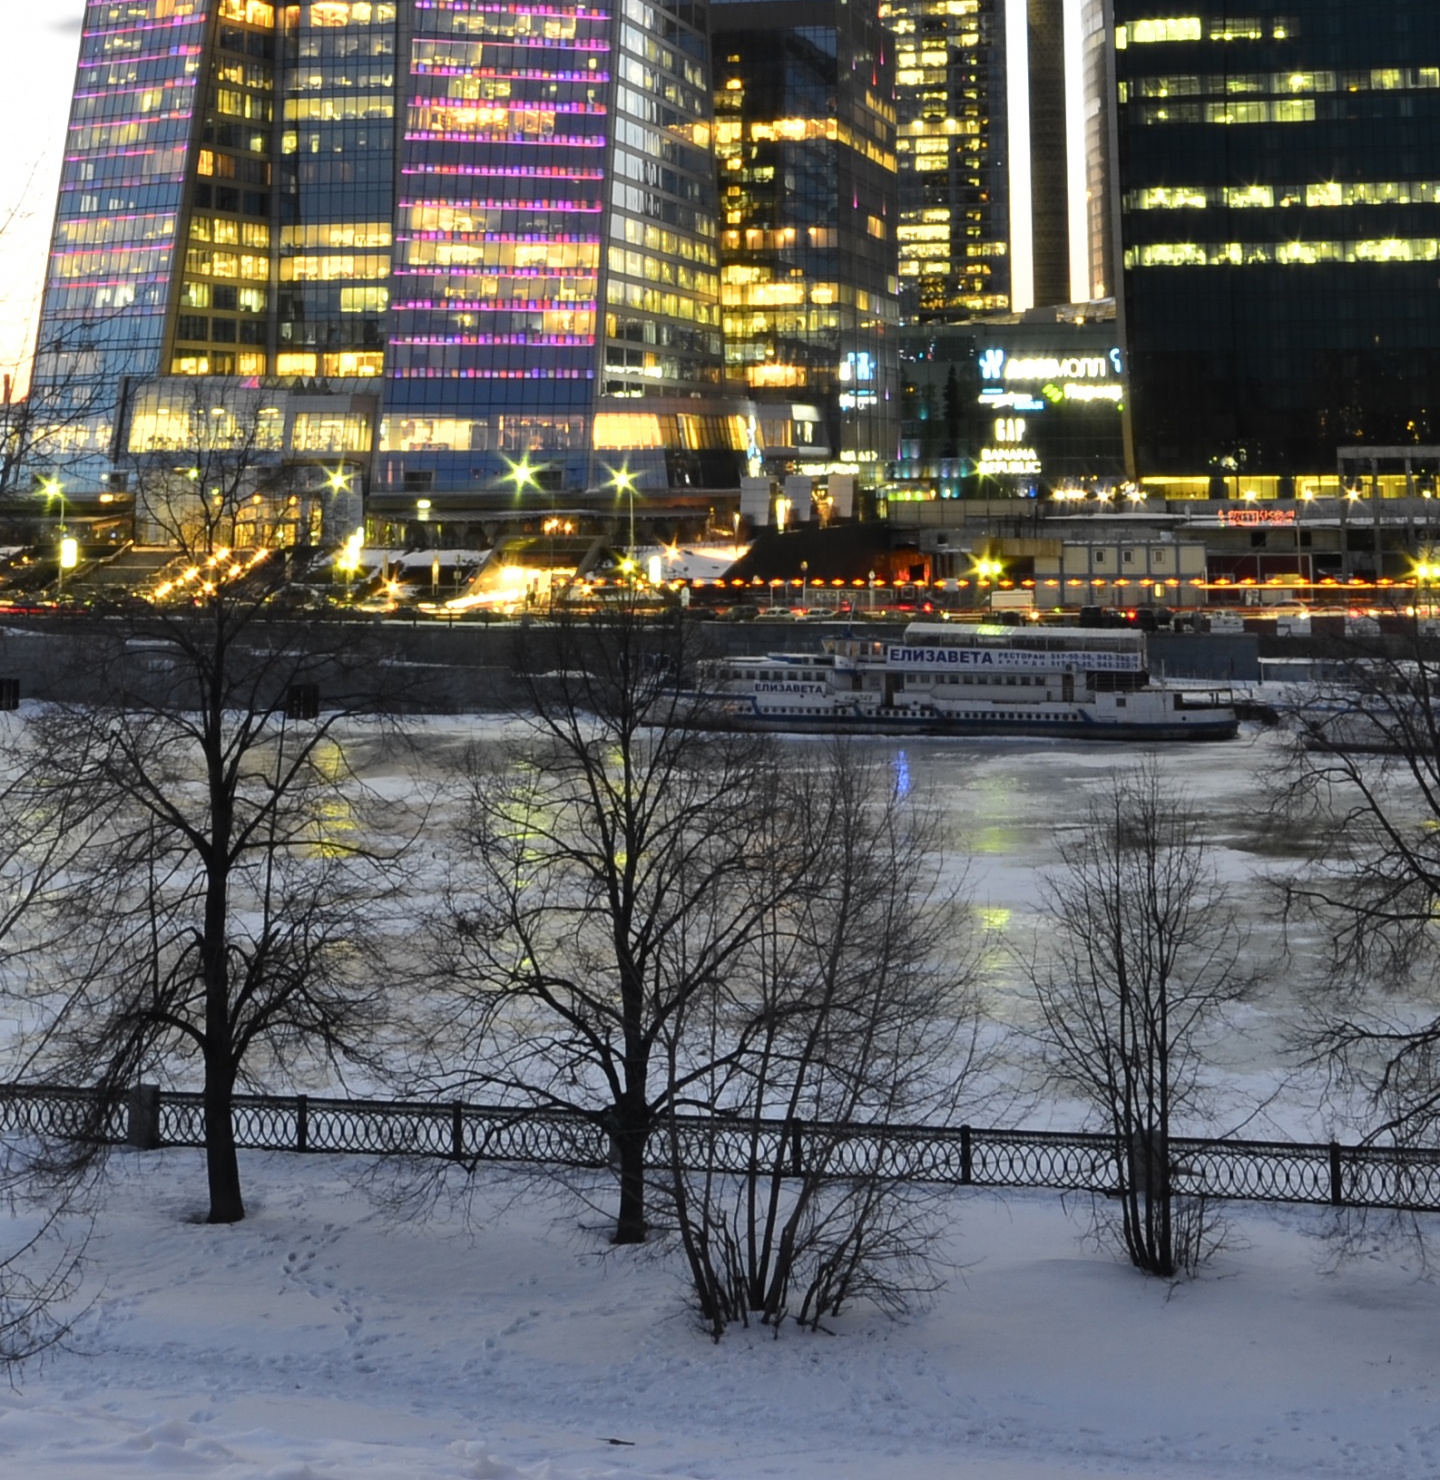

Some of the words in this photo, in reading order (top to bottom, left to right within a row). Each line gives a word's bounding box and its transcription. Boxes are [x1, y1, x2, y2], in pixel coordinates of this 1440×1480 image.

[994, 418, 1026, 441] GAP
[981, 448, 1038, 460] BANANA
[979, 461, 1041, 474] REPUBLIC
[890, 648, 994, 664] ЕЛИЗАВЕТА
[998, 652, 1045, 660] РЕСТОРАН
[755, 683, 824, 694] ЕЛИЗАВЕТА
